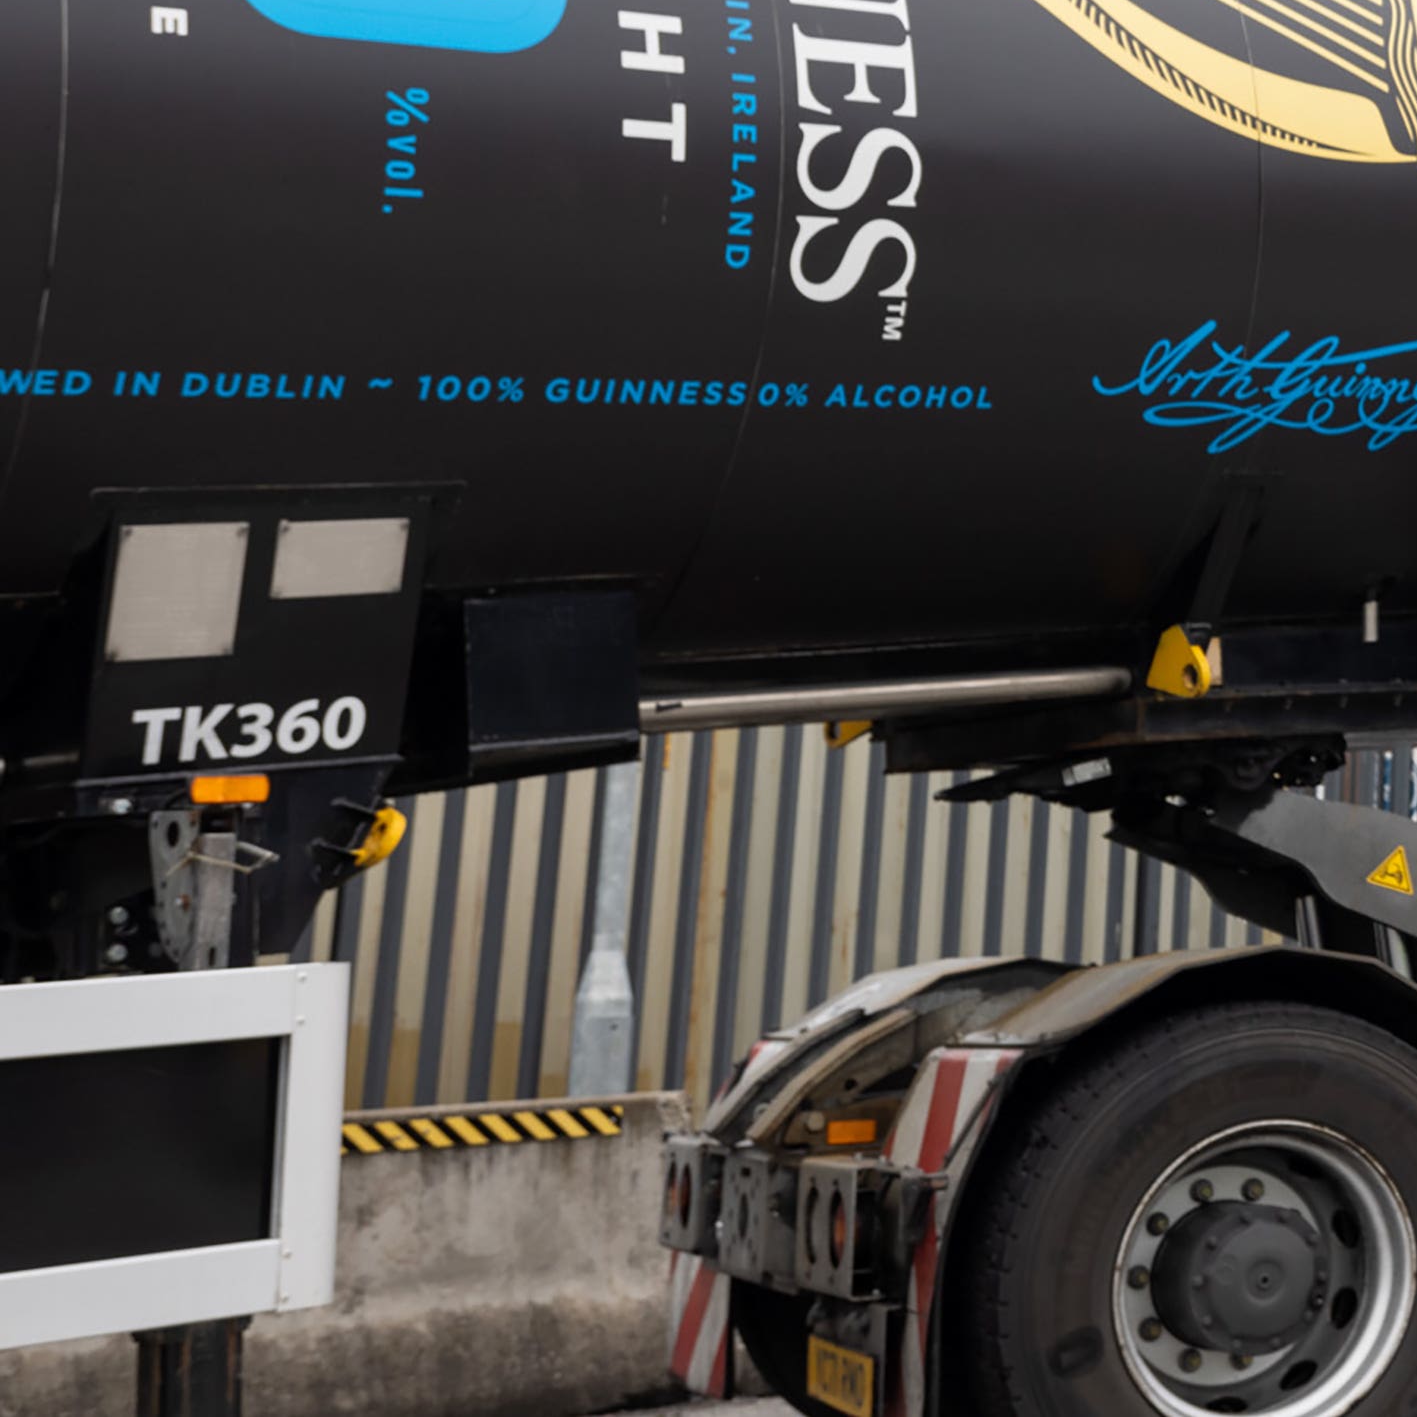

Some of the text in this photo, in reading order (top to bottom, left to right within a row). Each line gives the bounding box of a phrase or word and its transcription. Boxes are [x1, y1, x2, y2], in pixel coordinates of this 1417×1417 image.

[724, 73, 757, 271] IRELAND
[113, 370, 162, 397] IN
[180, 373, 347, 400] DUBLIN
[418, 374, 526, 403] 100%
[545, 377, 747, 406] GUINNESS
[758, 381, 809, 408] 0%
[825, 385, 993, 410] ALCOHOL
[131, 695, 368, 766] TK360
